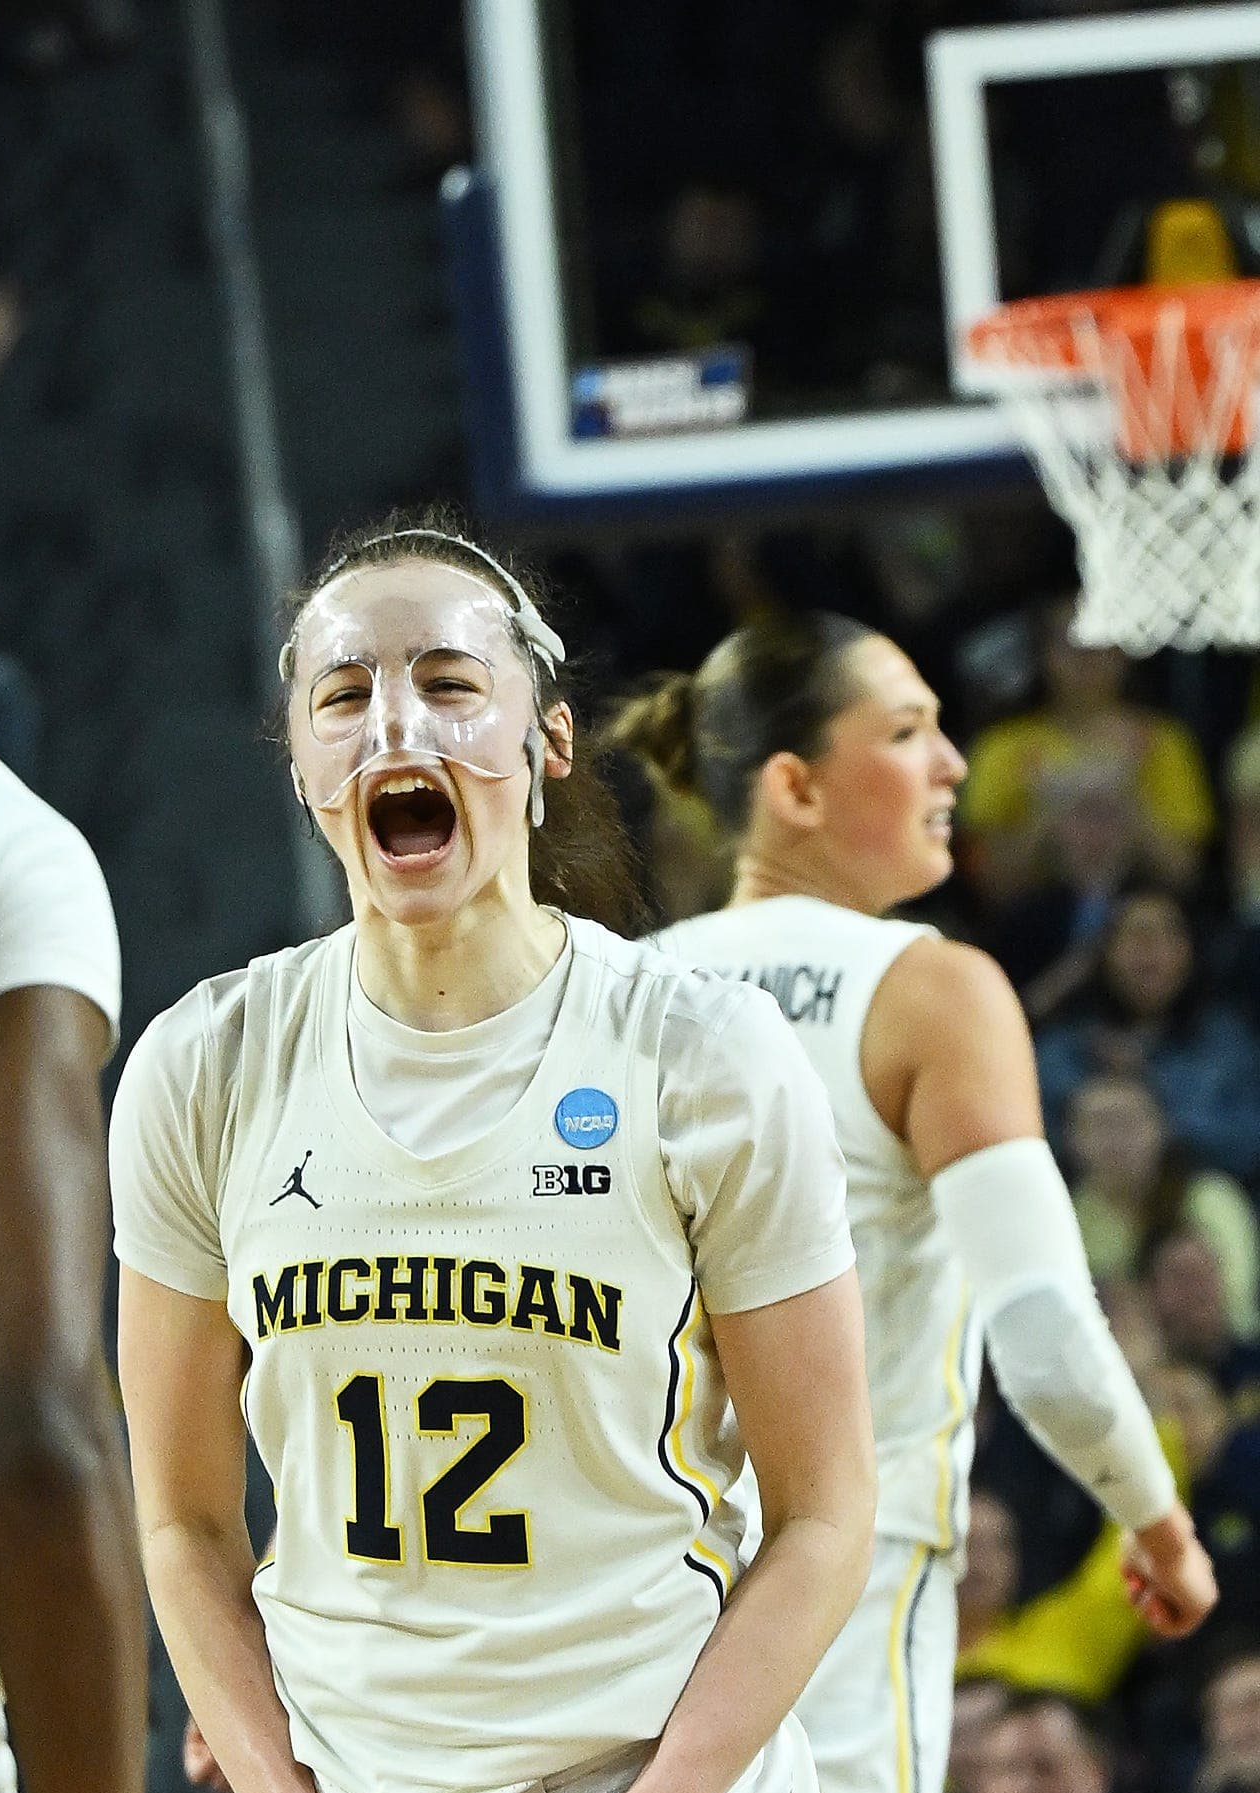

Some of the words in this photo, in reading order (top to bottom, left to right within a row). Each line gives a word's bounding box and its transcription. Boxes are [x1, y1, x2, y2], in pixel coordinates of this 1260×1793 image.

[564, 1113, 615, 1133] NCAA
[251, 1256, 623, 1355] MICHIGAN
[335, 1371, 532, 1568] 12
